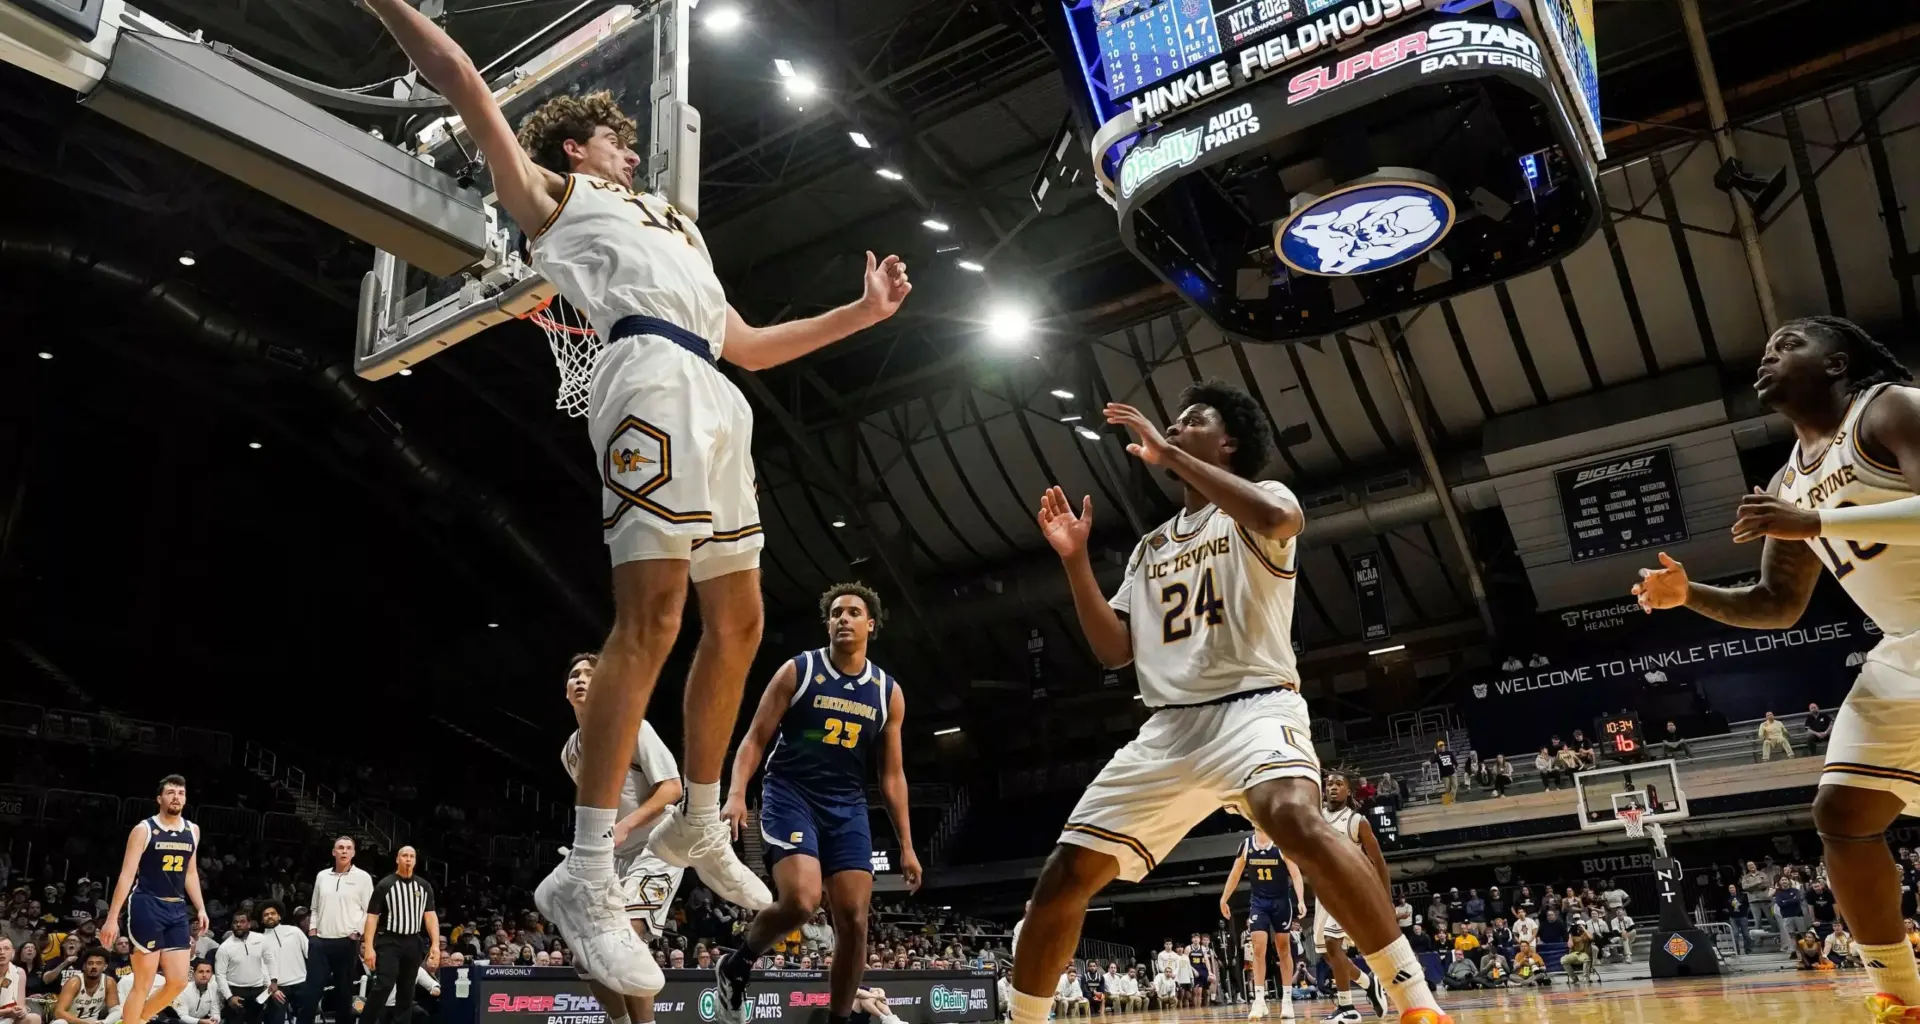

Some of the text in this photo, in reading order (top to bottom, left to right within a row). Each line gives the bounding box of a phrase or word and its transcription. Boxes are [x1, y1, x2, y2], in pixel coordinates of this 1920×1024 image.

[1183, 16, 1209, 40] 17
[1228, 8, 1255, 34] NIT
[1107, 49, 1120, 60] 10
[1129, 42, 1136, 51] 0
[1164, 25, 1171, 34] 0
[1127, 30, 1134, 39] 0
[1109, 60, 1122, 72] 14
[1132, 53, 1139, 62] 0
[1167, 37, 1174, 46] 0
[1112, 71, 1125, 83] 24
[1134, 64, 1141, 74] 2
[1169, 49, 1176, 58] 0
[1421, 50, 1545, 80] BATTERIES
[1113, 60, 1179, 95] 77 2 0 0
[1132, 60, 1231, 124] HINKLE
[1208, 102, 1253, 133] AUTO
[1204, 116, 1260, 151] PARTS
[1122, 128, 1202, 197] O'Reilly
[1806, 463, 1858, 509] IRVINE
[1356, 566, 1379, 583] NCAA
[1161, 566, 1225, 645] 24
[1584, 617, 1625, 632] HEALTH
[1494, 665, 1594, 697] WELCOME
[1596, 659, 1626, 679] TO
[1628, 645, 1706, 673] HINKLE
[1708, 621, 1853, 660] FIELDHOUSE
[822, 717, 863, 749] 23
[1606, 720, 1634, 733] 10:34
[1615, 734, 1634, 752] 16
[162, 854, 184, 872] 22
[874, 863, 891, 871] ARTS
[1581, 853, 1652, 874] BUTLER
[1256, 868, 1273, 881] 11
[1391, 880, 1431, 897] TLER
[485, 968, 532, 976] #DAWGSONLY
[488, 993, 601, 1012] SUPERSTAR
[758, 992, 780, 1006] AUTO
[914, 996, 922, 1005] AT
[931, 985, 968, 1013] O'Reilly
[970, 988, 985, 999] AUTO
[675, 1002, 686, 1012] AT
[755, 1004, 783, 1019] PARTS
[969, 999, 988, 1010] PARTS
[547, 1015, 606, 1024] BATTERIES
